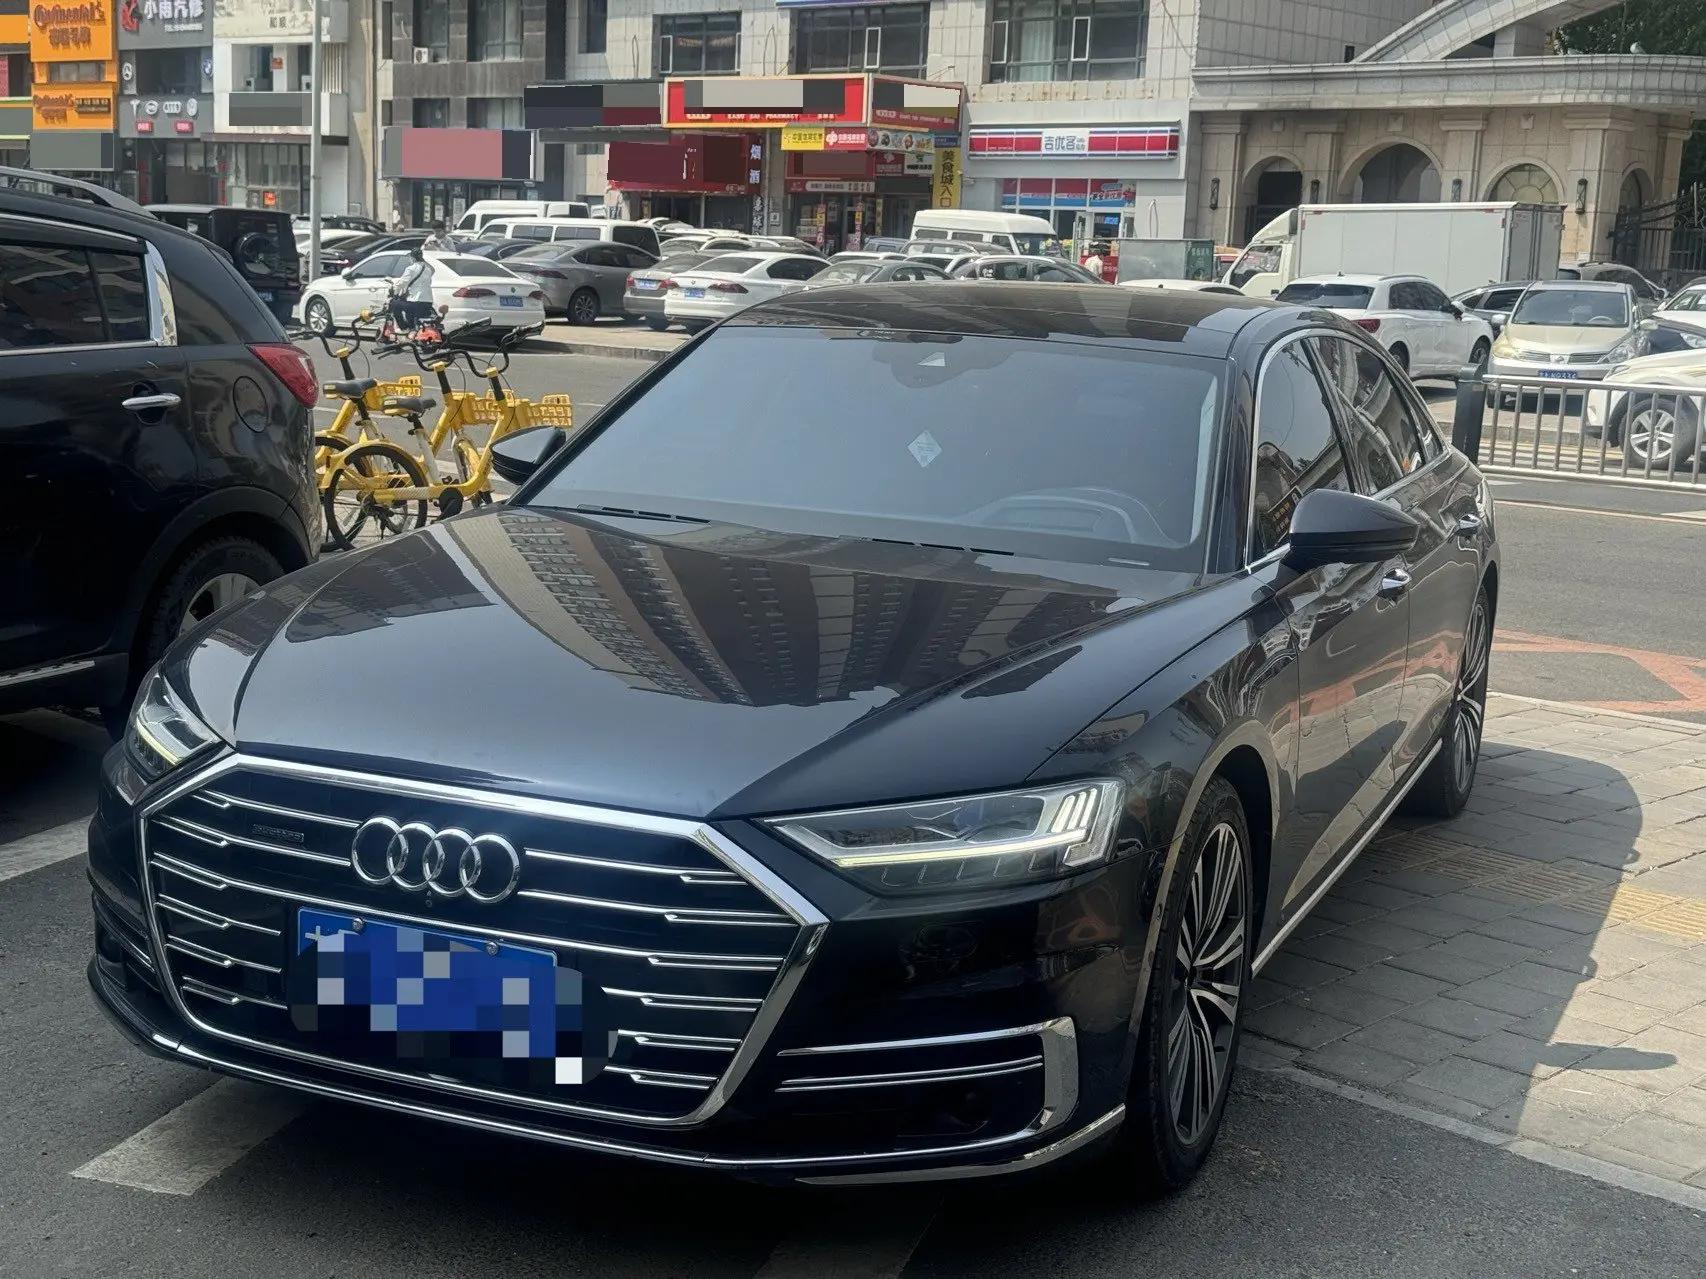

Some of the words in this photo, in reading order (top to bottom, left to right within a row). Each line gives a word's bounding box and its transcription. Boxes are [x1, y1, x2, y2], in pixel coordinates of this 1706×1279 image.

[940, 150, 955, 208] 美食城入口
